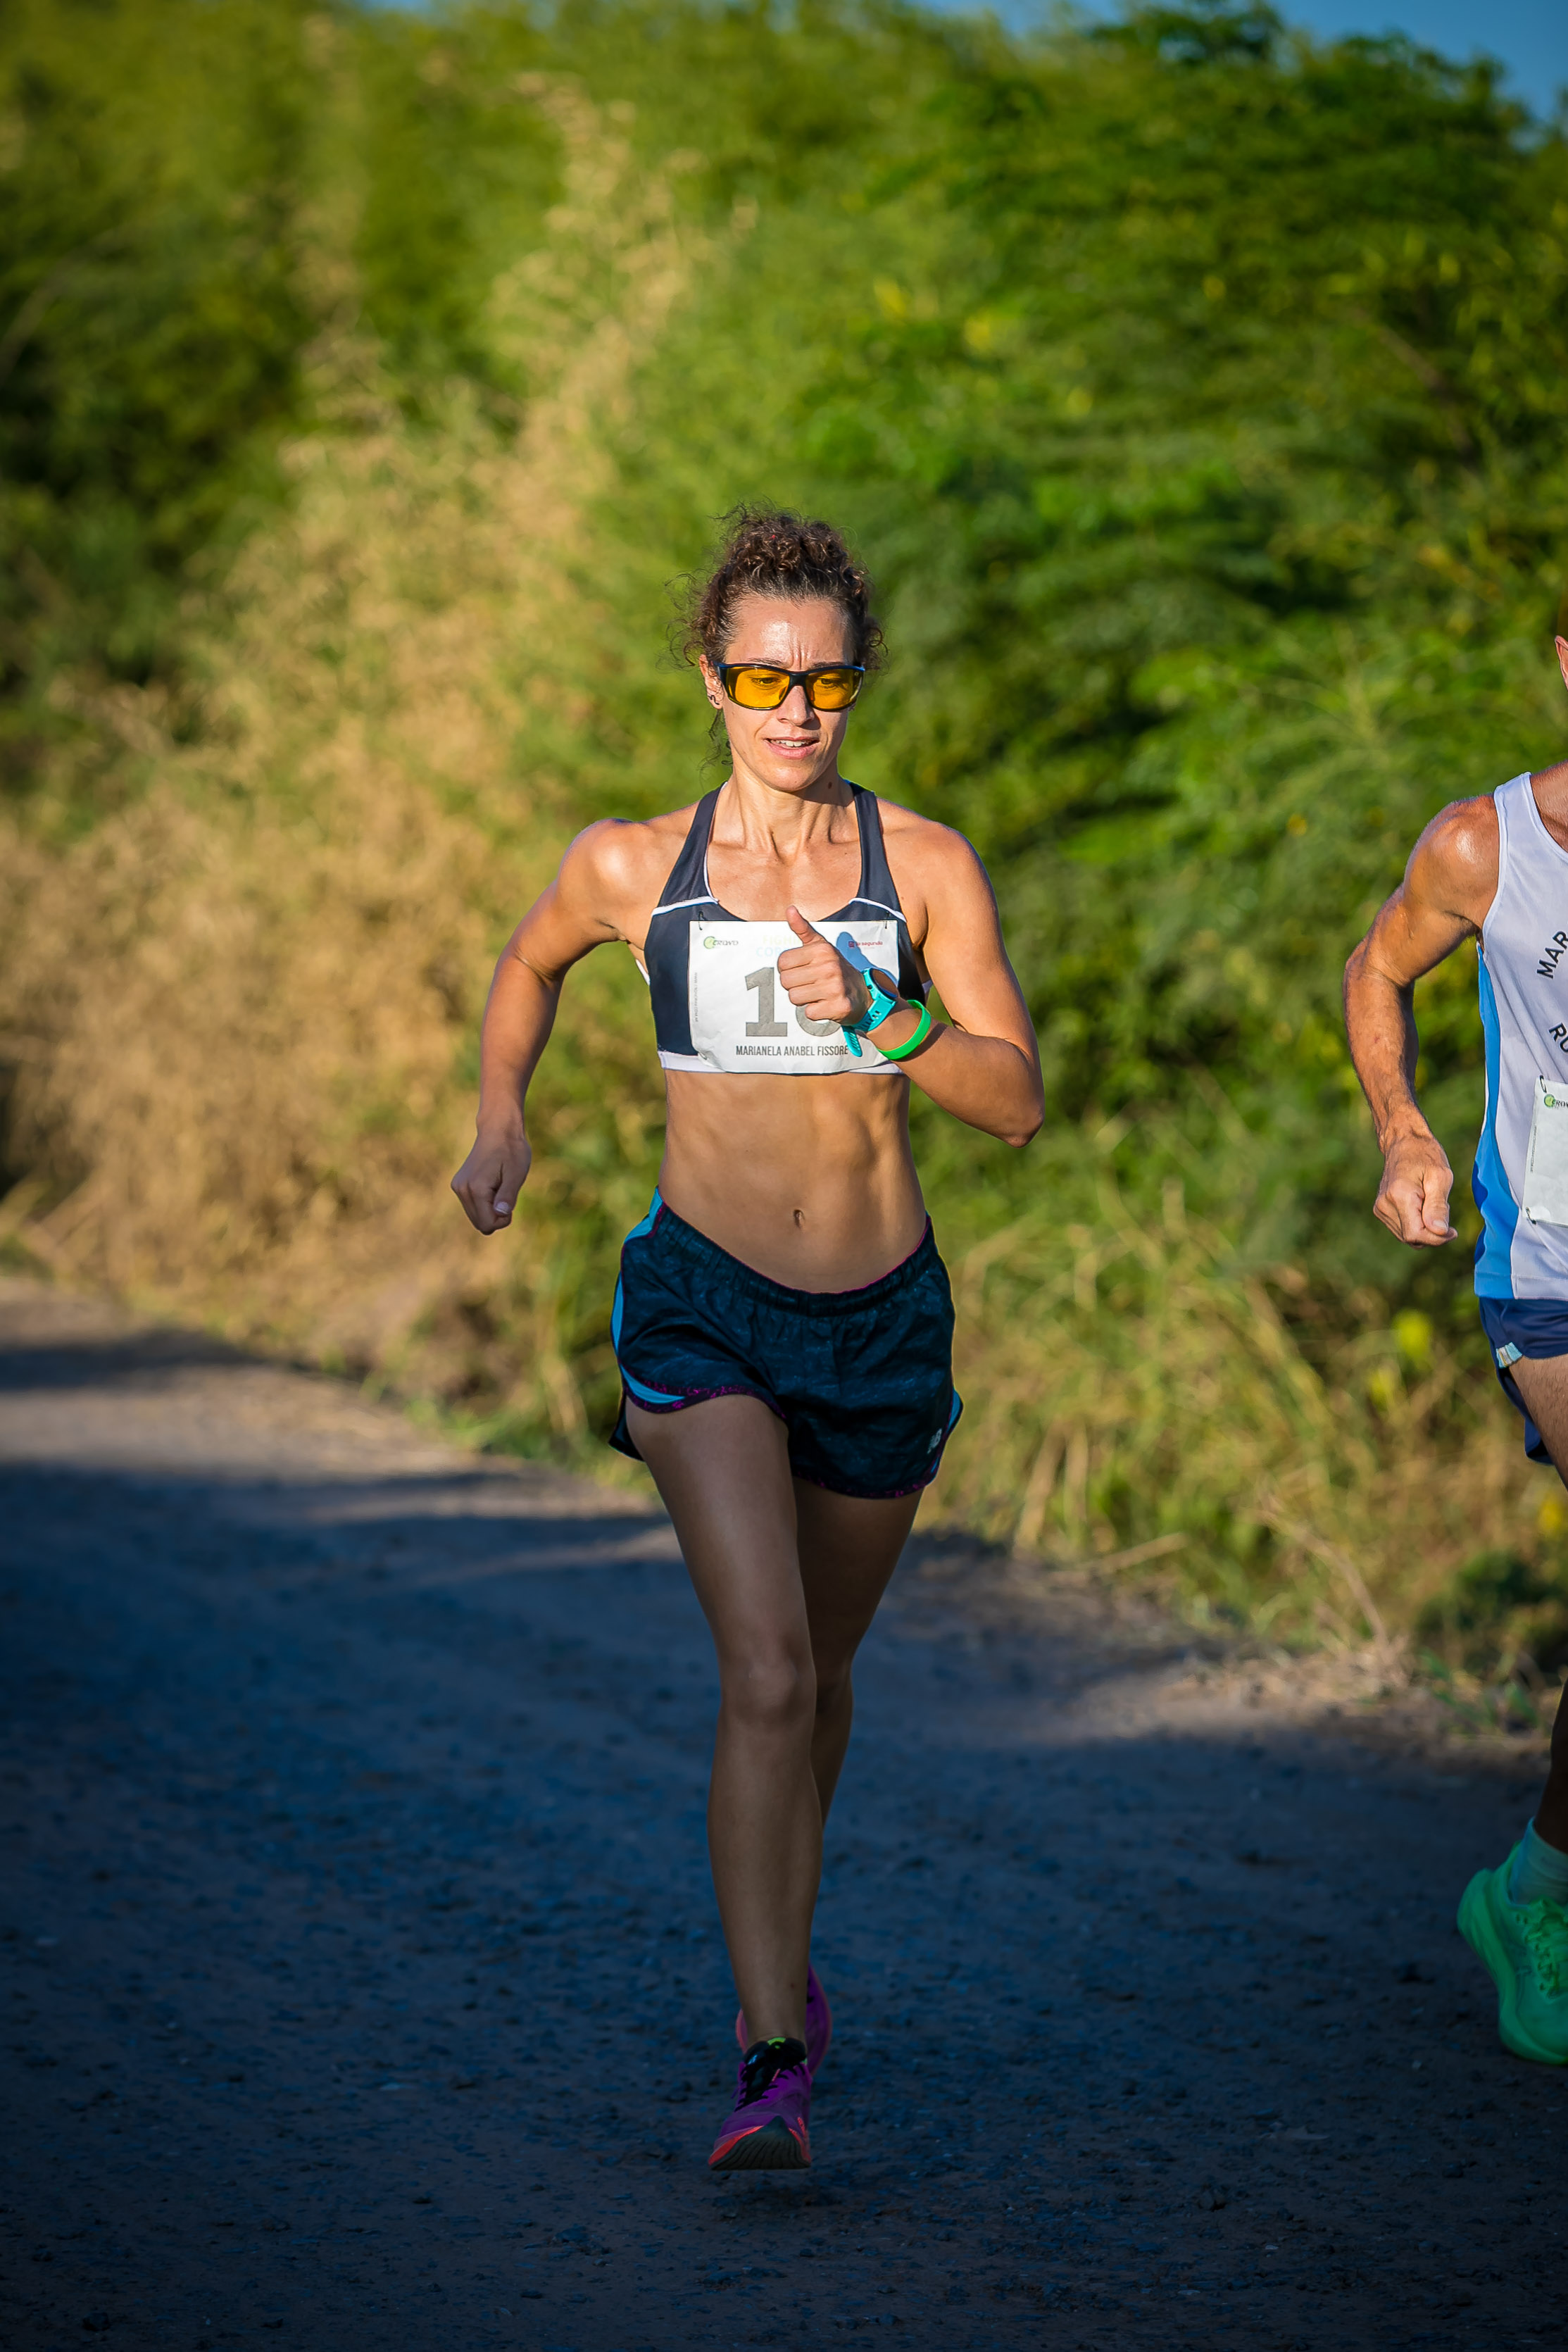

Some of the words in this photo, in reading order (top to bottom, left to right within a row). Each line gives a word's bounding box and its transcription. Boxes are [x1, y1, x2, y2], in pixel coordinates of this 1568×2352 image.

[736, 1045, 782, 1056] MARIANELA
[784, 1046, 815, 1056] ANABEL
[817, 1045, 848, 1056] FISSORE
